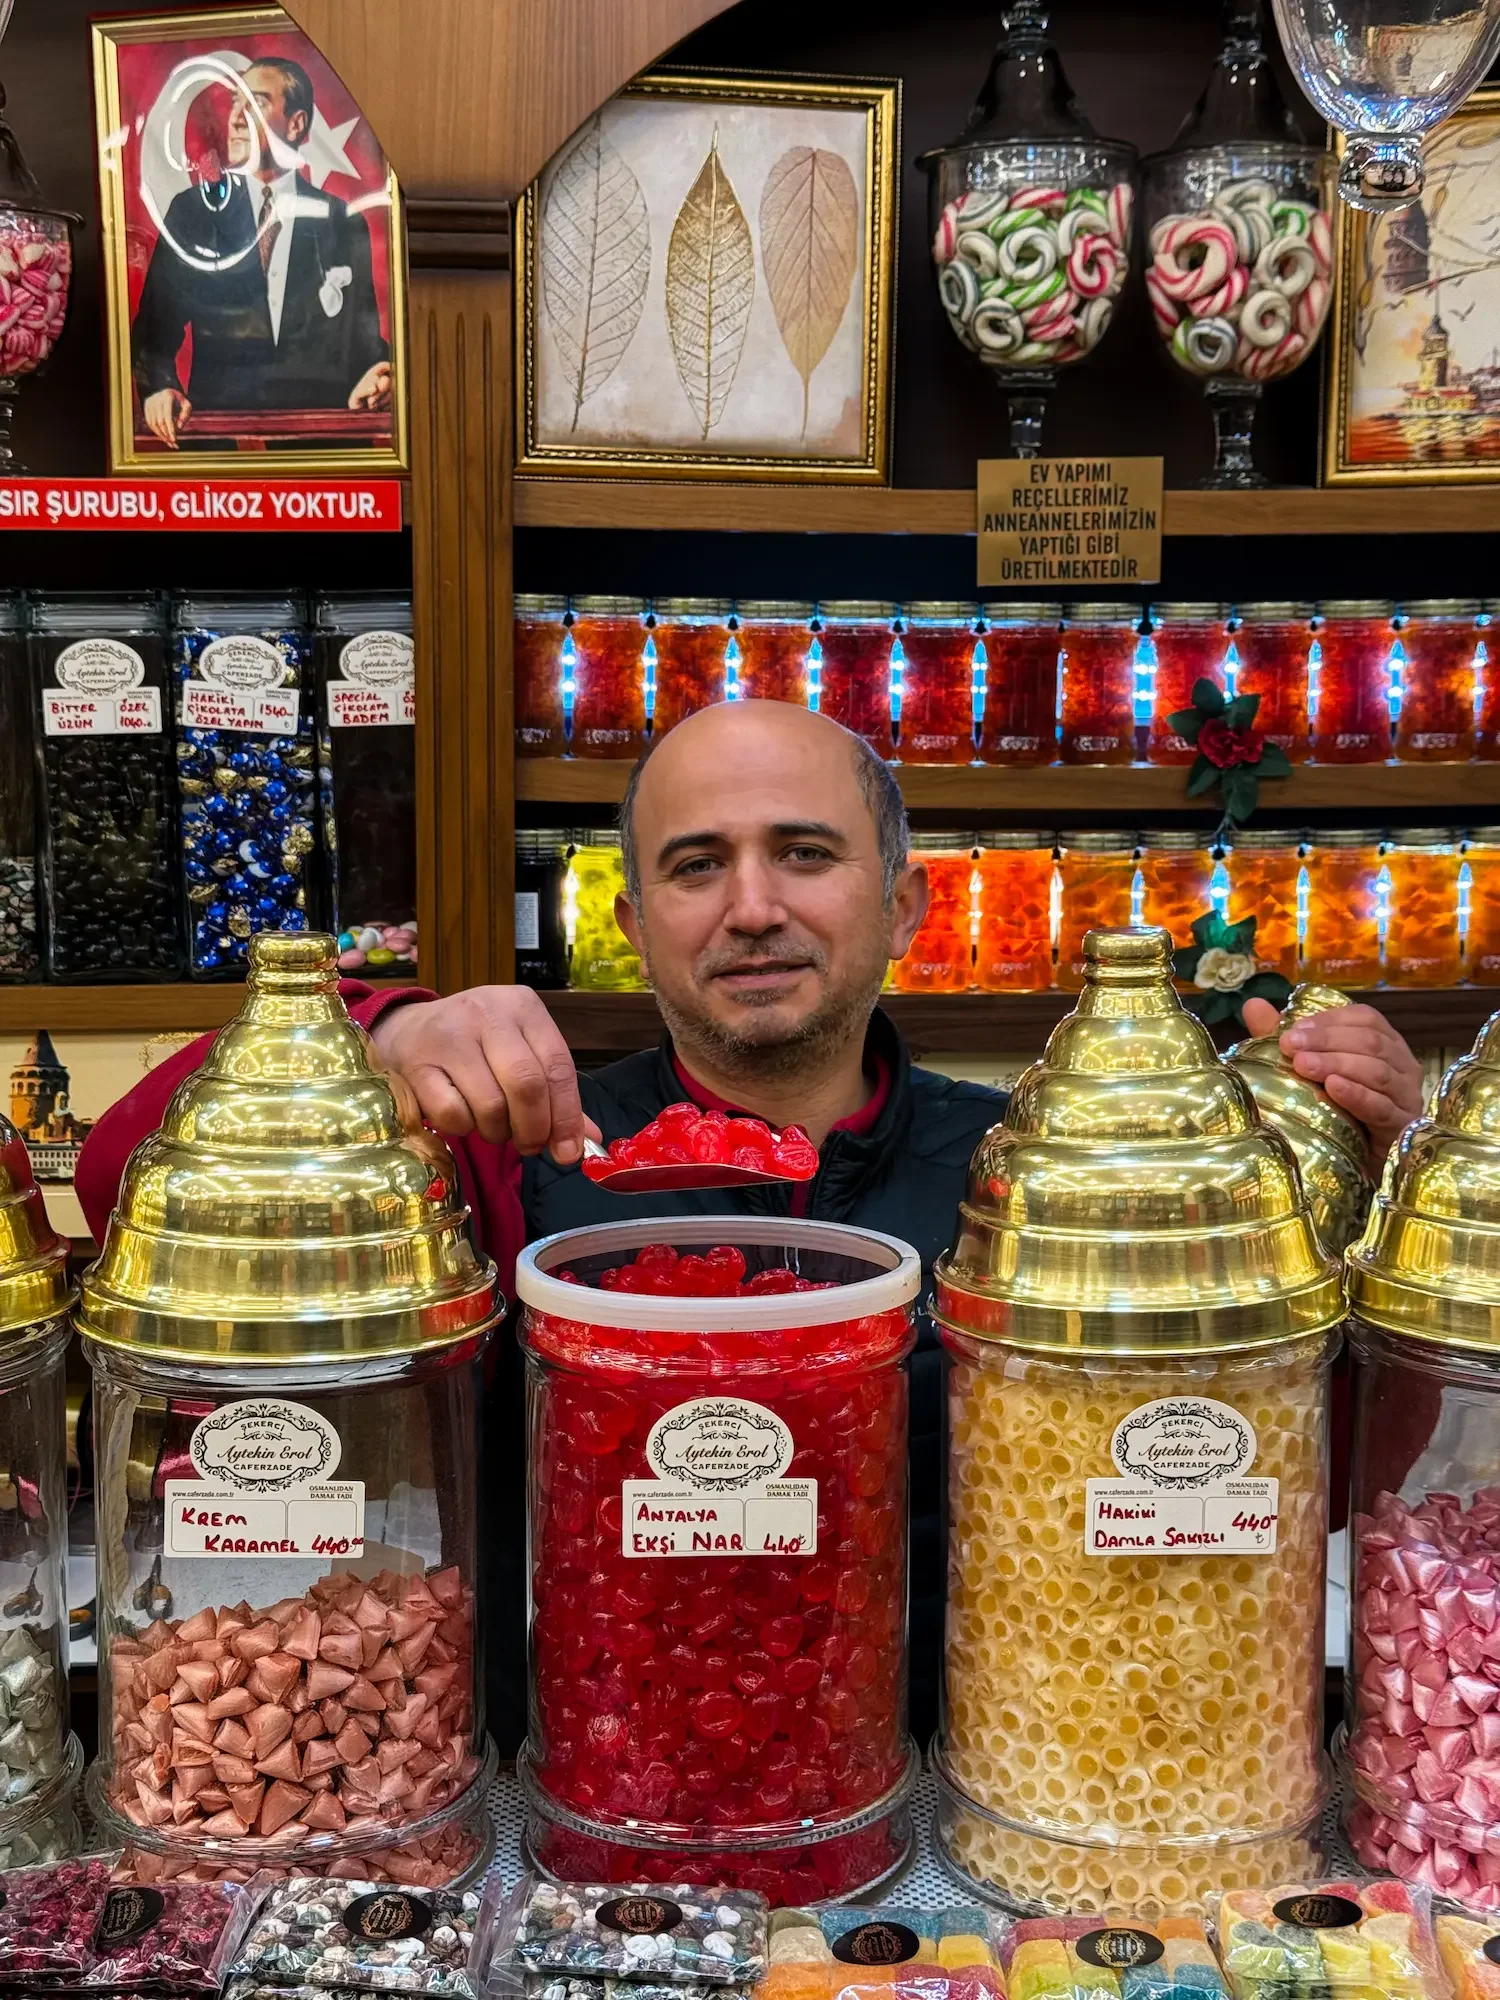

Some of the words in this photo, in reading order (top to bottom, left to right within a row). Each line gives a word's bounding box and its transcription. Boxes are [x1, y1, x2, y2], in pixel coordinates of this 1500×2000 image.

[1031, 464, 1050, 483] EV
[1055, 463, 1111, 483] YAPIMI
[46, 490, 164, 524] ŞURUBU,
[171, 485, 263, 519] GLİKOZ
[269, 491, 383, 519] YOKTUR.
[1012, 484, 1129, 511] REÇELLERİMİZ
[983, 508, 1157, 532] ANNEANNELERİMİZİN
[1019, 533, 1080, 555] YAPTIĞI
[1086, 532, 1120, 555] GİBİ
[1001, 556, 1138, 580] ÜRETİLMEKTEDİR
[343, 713, 389, 724] BADEM
[240, 1420, 285, 1432] ŞEKERCİ
[698, 1419, 742, 1431] ŞEKERCİ
[1161, 1418, 1204, 1429] ŞEKERCİ
[217, 1444, 276, 1464] Aytekin
[280, 1444, 313, 1459] Erol
[675, 1444, 733, 1463] Aytekin
[736, 1444, 770, 1459] Erol
[1138, 1442, 1195, 1462] Aytekin
[1198, 1442, 1232, 1457] Erol
[233, 1463, 293, 1471] CAFERZADE
[1153, 1461, 1211, 1469] CAFERZADE
[181, 1507, 248, 1527] KREM
[637, 1502, 718, 1523] ANTALYA
[204, 1534, 300, 1553] KARAMEL
[632, 1532, 675, 1555] EKŞİ
[692, 1532, 744, 1552] NAR
[1094, 1530, 1155, 1548] DAMLA
[1163, 1527, 1225, 1547] SAKIZLI
